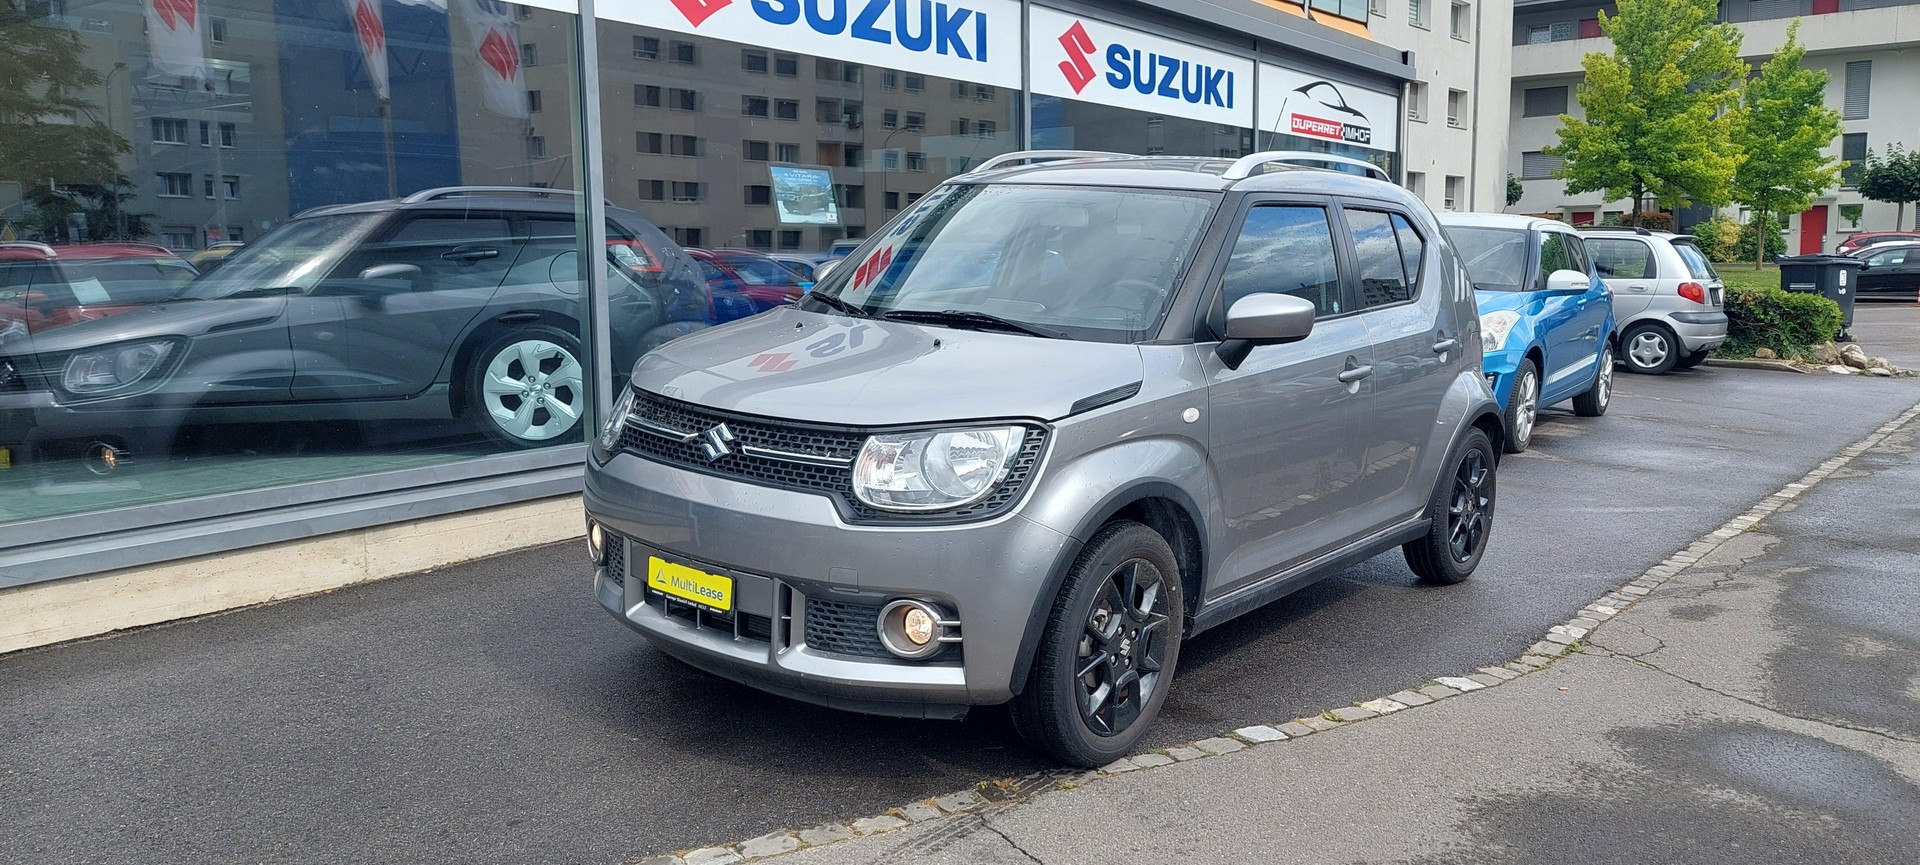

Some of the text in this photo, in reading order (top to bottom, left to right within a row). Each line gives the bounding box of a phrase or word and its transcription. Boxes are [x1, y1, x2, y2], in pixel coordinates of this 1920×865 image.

[1106, 43, 1234, 109] SUZUKI
[1292, 118, 1371, 142] DUPERRET IMHOF
[671, 575, 723, 601] MultiLease
